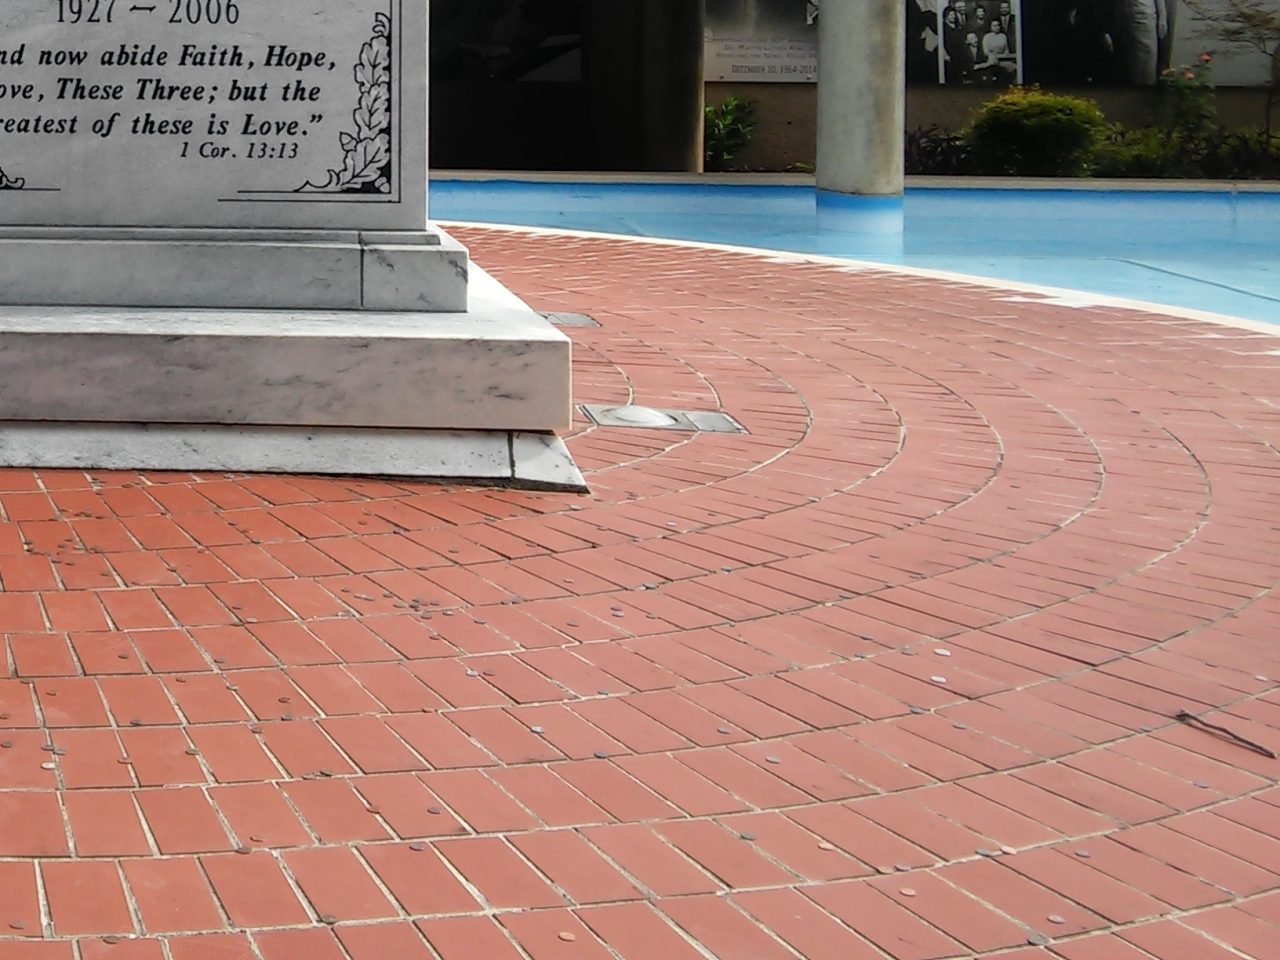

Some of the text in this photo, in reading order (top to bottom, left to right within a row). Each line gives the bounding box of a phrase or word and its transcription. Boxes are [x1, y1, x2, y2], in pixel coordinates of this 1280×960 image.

[38, 49, 89, 66] now
[100, 43, 168, 67] abide
[177, 44, 255, 71] Faith,
[262, 44, 336, 72] Hope,
[56, 77, 124, 101] These
[135, 77, 219, 105] Three;
[227, 78, 269, 102] but
[281, 79, 321, 103] the
[91, 112, 121, 139] of
[131, 112, 194, 136] these
[207, 112, 230, 136] is
[180, 141, 299, 159] 1 Cor. 13:13
